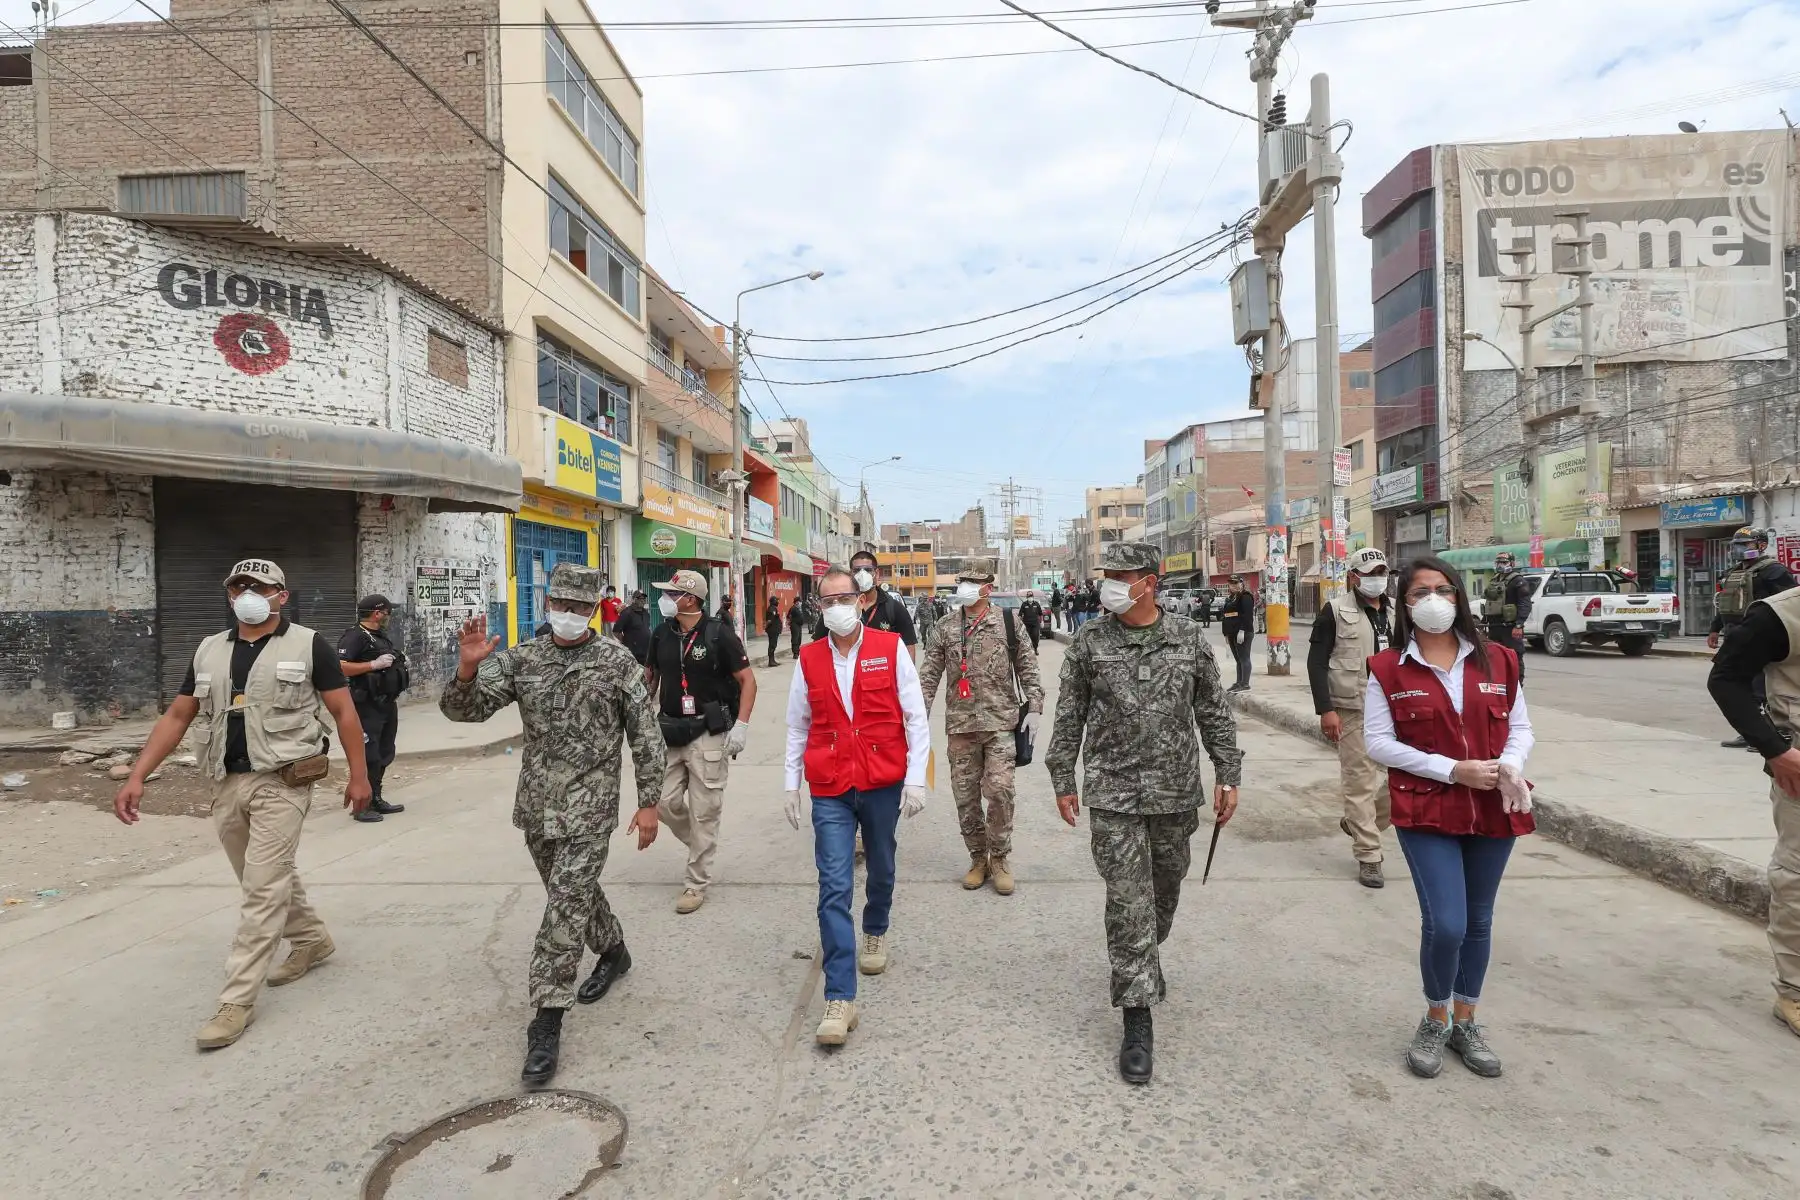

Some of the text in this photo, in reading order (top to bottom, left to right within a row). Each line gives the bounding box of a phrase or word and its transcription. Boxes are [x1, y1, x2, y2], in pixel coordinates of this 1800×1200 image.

[1476, 165, 1575, 197] TODO
[1723, 162, 1766, 186] es
[1491, 215, 1744, 276] trome
[157, 263, 334, 341] GLORIA
[245, 422, 309, 444] GLORIA
[568, 445, 592, 473] bitel
[598, 458, 621, 475] KENNEDY
[1555, 458, 1586, 471] VETERINAR
[1552, 467, 1586, 480] CONCENTRA
[1501, 481, 1528, 503] DOG
[1577, 519, 1619, 529] PIEL VIDA
[418, 585, 431, 599] 23
[453, 586, 464, 599] 23
